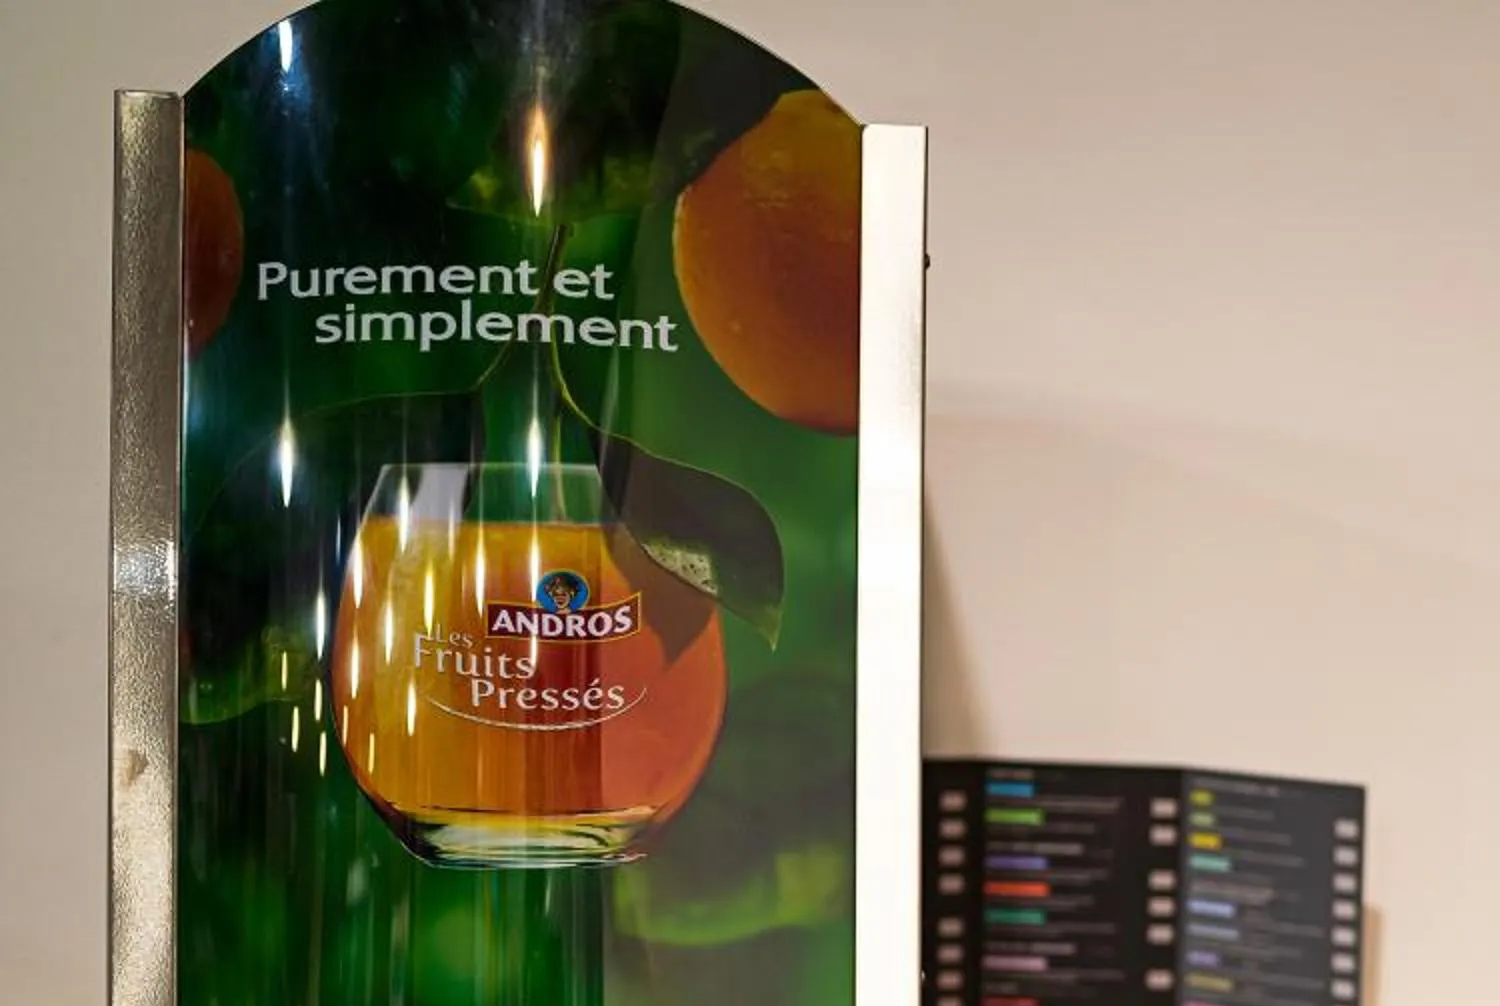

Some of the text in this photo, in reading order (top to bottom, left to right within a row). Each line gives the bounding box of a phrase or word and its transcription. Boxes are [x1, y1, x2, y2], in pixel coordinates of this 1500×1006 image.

[258, 260, 614, 300] Purement et
[315, 299, 679, 352] simplement
[436, 624, 474, 648] Les
[492, 605, 633, 638] ANDROS
[414, 631, 535, 679] Fruits
[471, 677, 625, 711] Pressés
